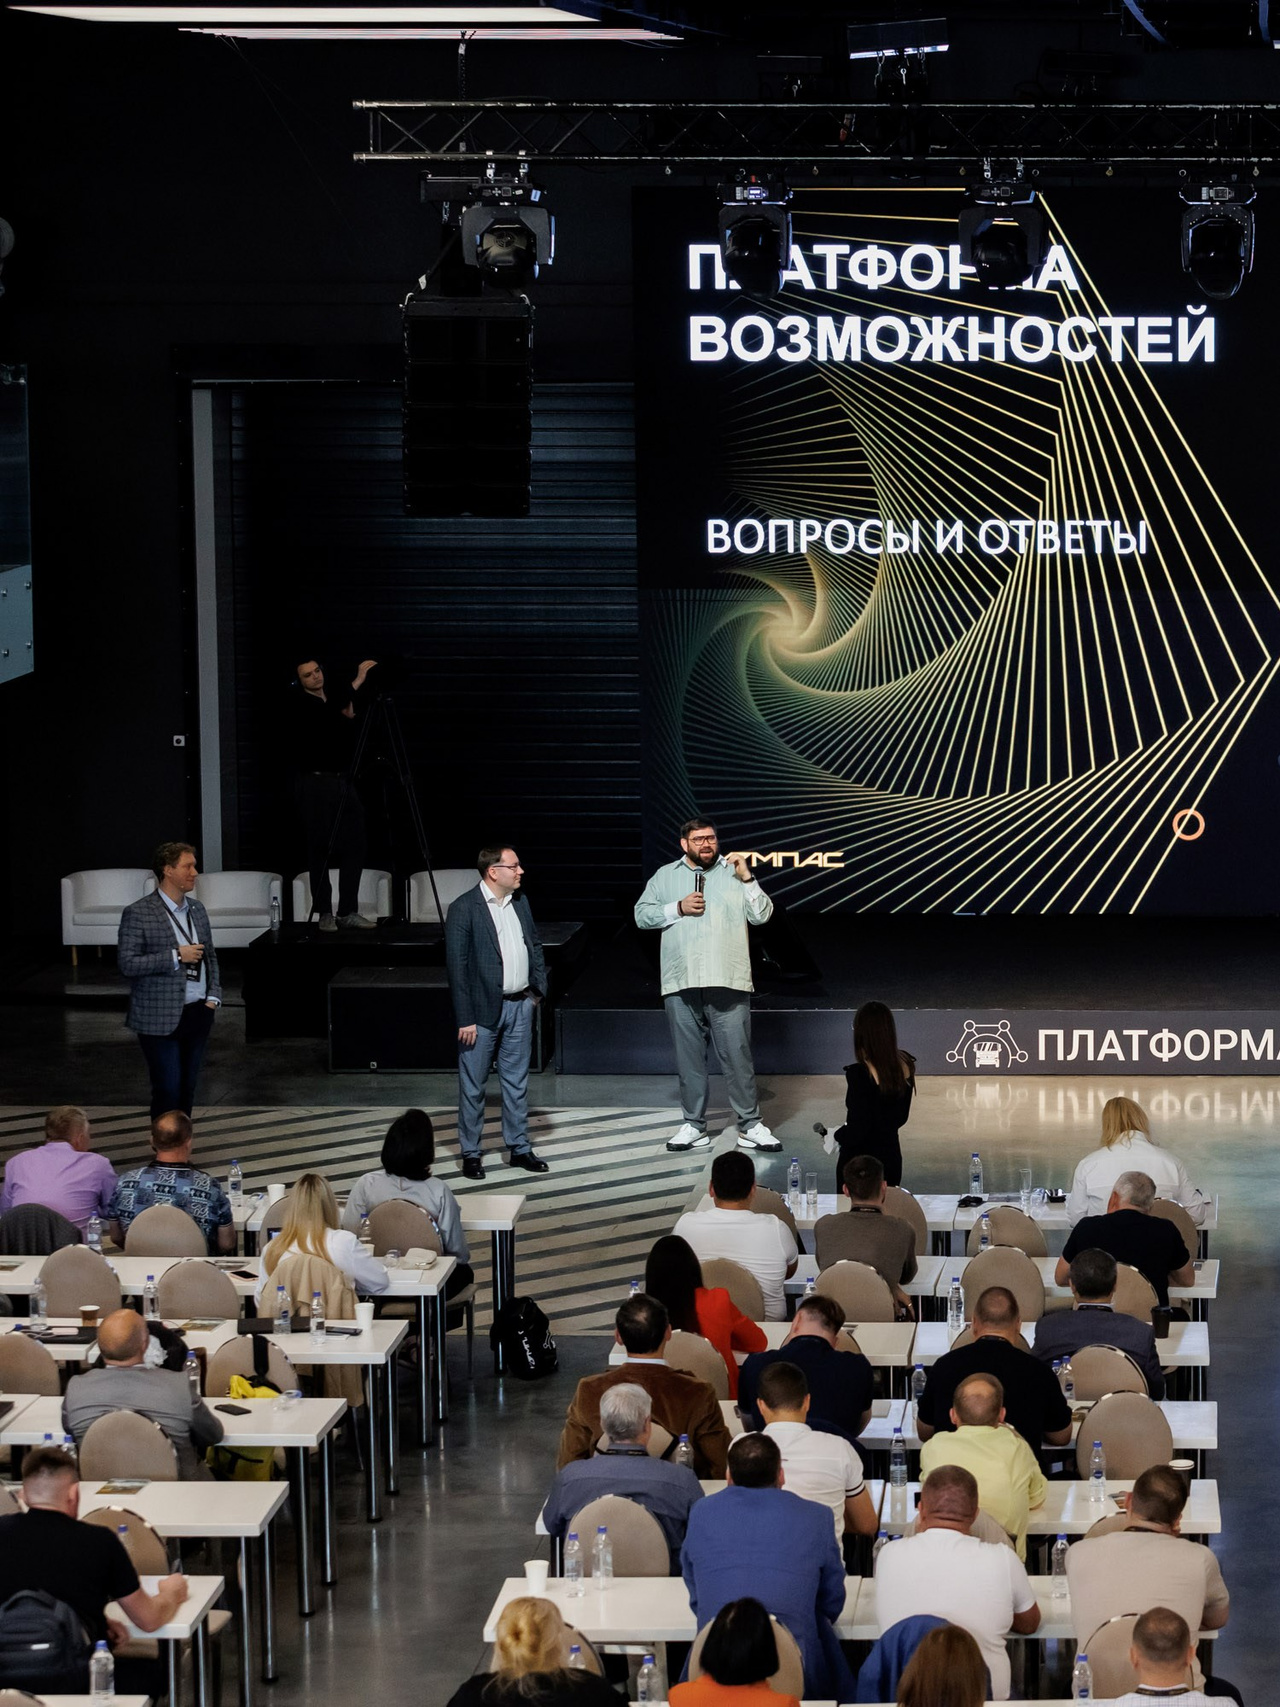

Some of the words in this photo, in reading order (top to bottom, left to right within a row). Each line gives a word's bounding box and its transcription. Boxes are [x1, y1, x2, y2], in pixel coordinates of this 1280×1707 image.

[689, 244, 1080, 290] ПАТФОРА
[689, 304, 1215, 362] ВОЗМОЖНОСТЕЙ
[707, 519, 920, 555] ВОПРОСЫ
[937, 519, 964, 555] И
[979, 519, 1149, 555] ОТВЕТЫ
[724, 852, 845, 868] МПАС
